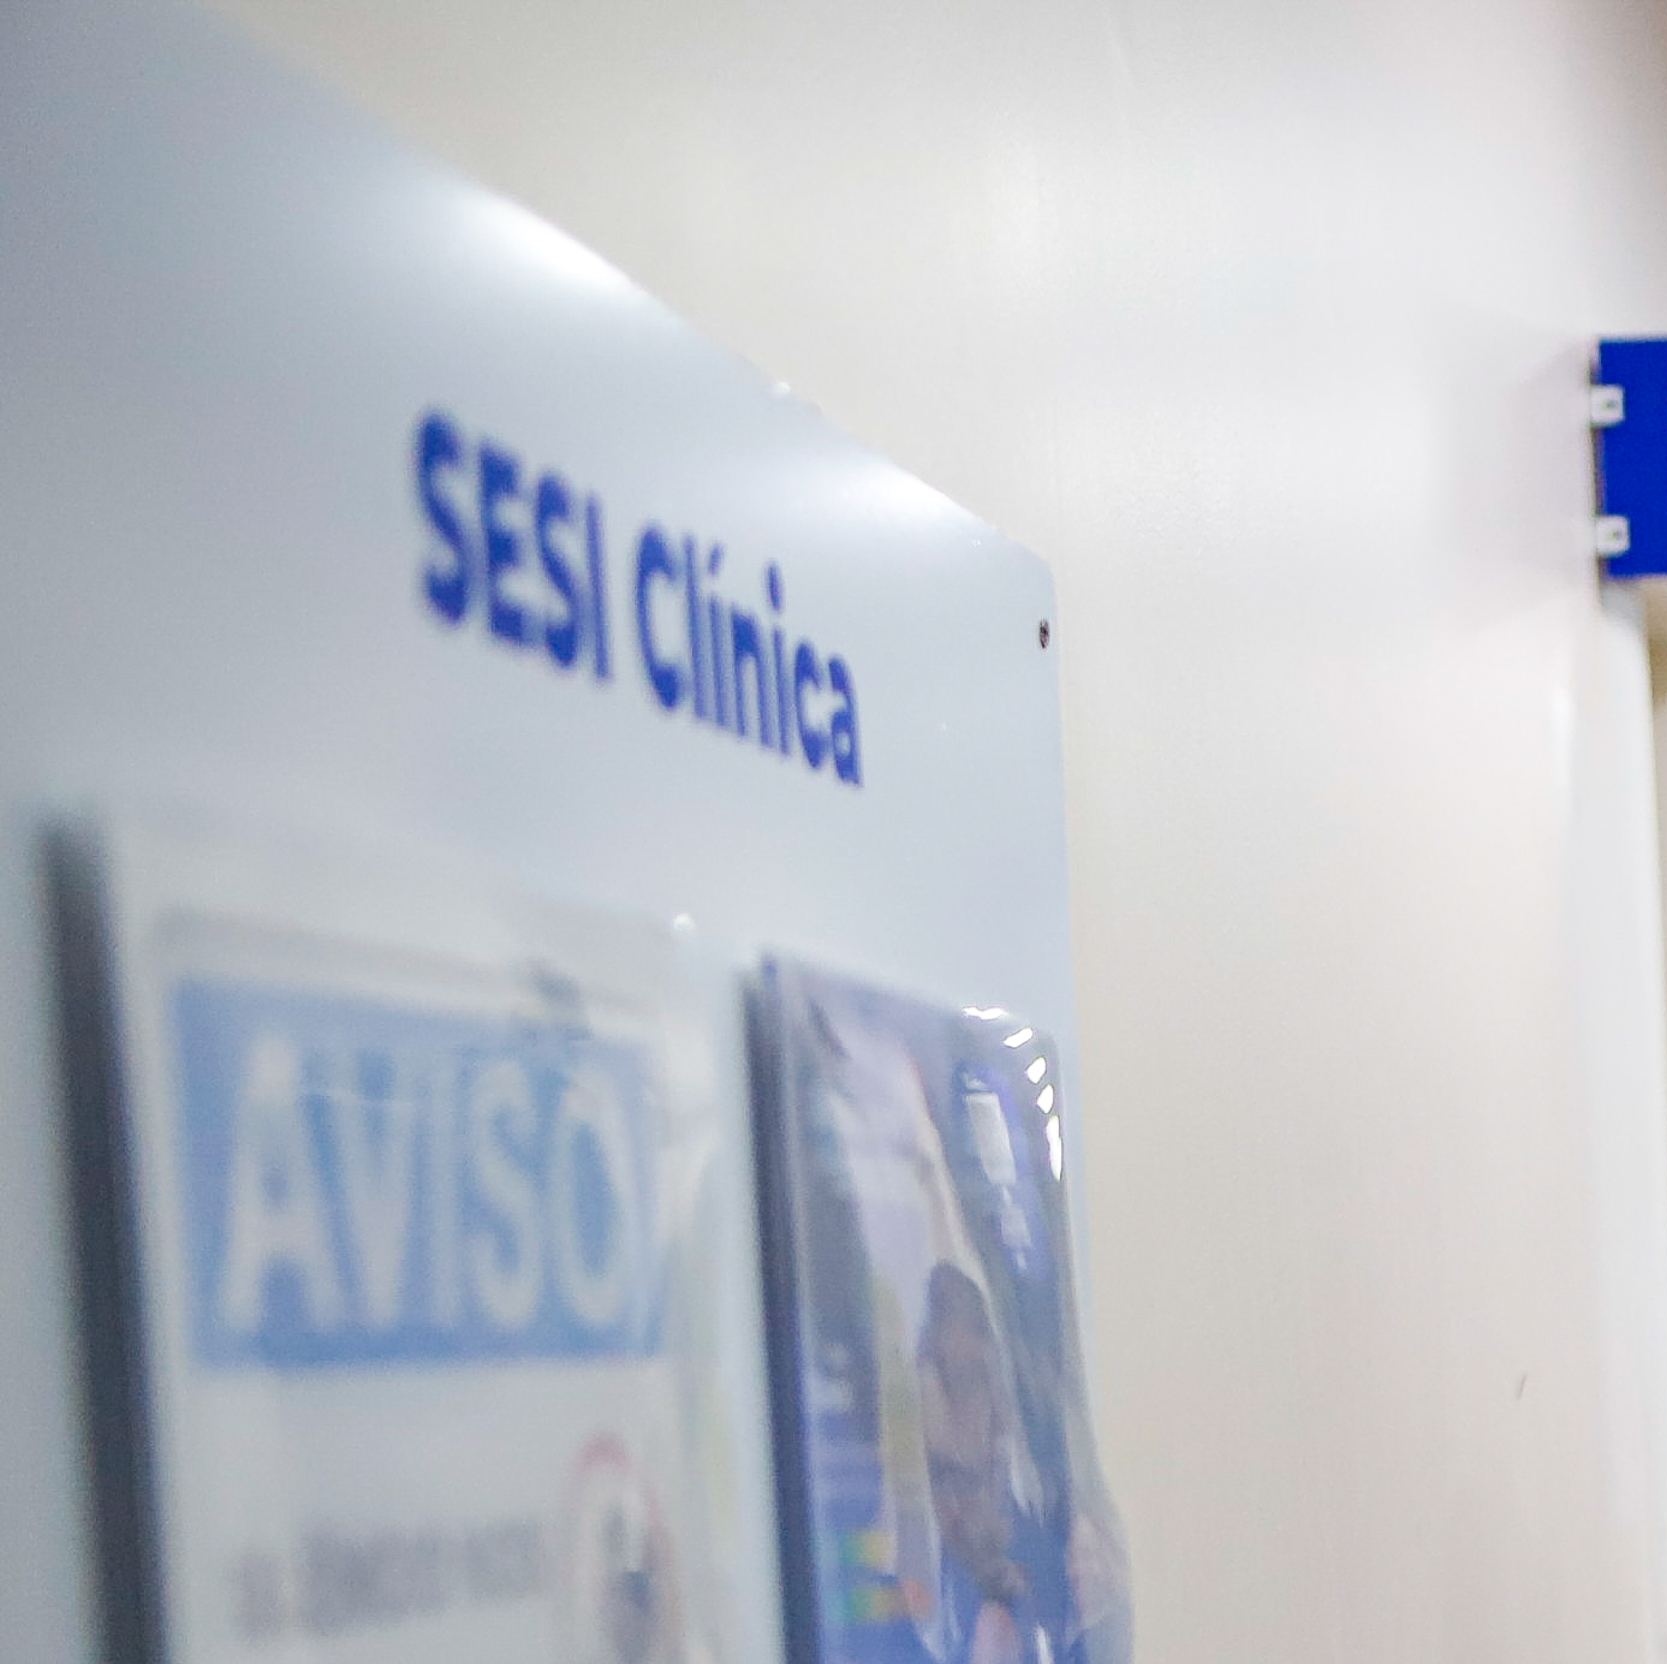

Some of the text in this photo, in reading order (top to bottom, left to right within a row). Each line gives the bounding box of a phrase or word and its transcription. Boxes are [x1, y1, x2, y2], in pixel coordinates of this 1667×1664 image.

[413, 405, 863, 787] SESI Clínica
[221, 1032, 639, 1328] AVISO
